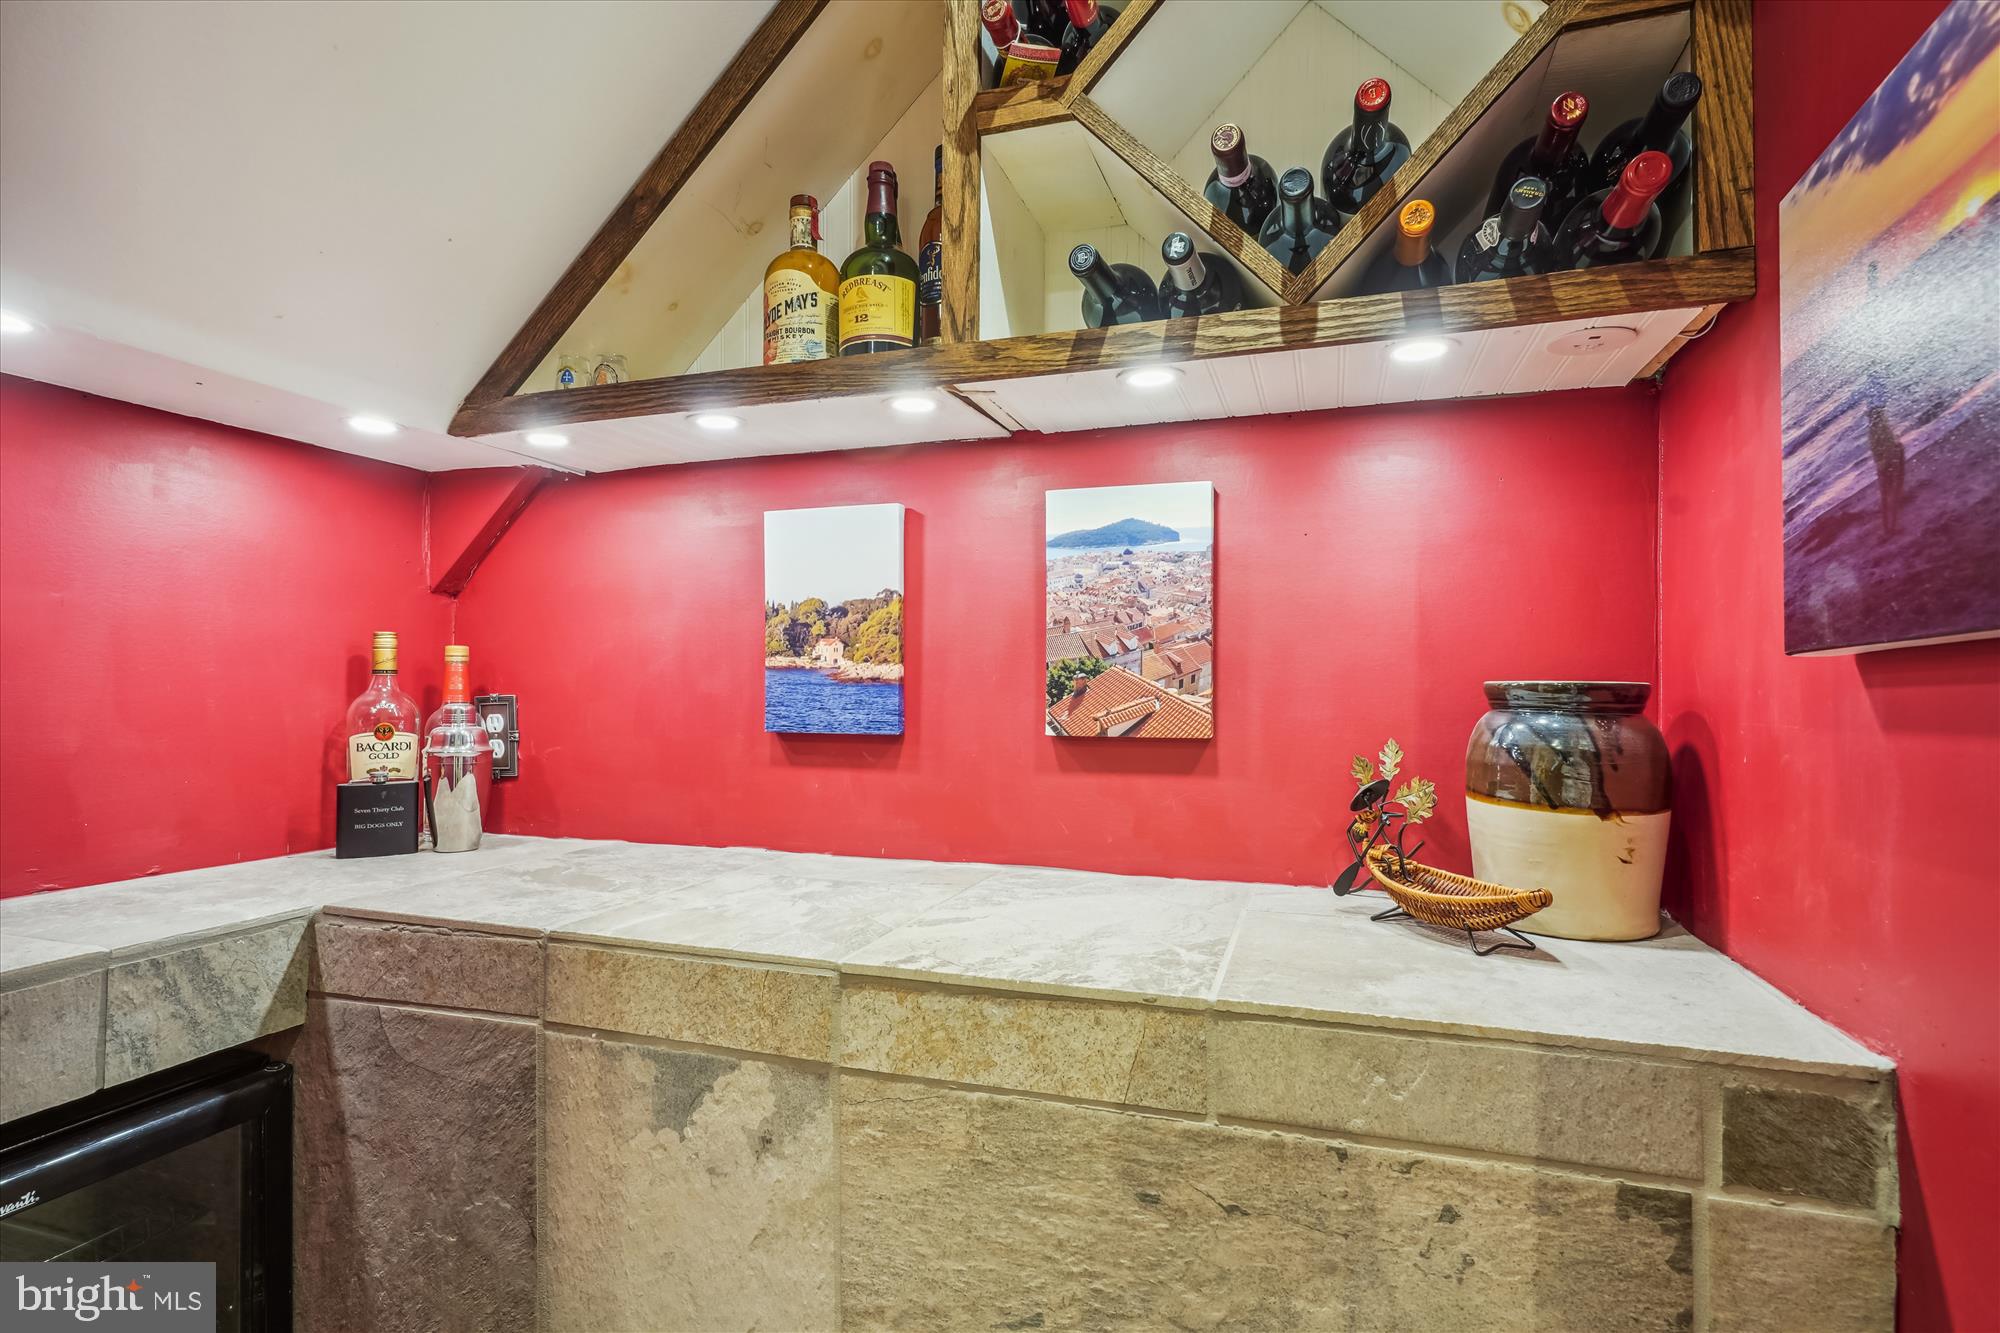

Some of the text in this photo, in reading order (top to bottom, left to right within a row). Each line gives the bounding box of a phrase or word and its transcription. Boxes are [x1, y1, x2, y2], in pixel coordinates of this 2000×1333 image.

[842, 278, 888, 299] REDBREAST
[784, 292, 818, 316] MAY'S
[854, 313, 869, 324] 12
[784, 327, 816, 335] BOURBON
[356, 741, 412, 752] BACARDI
[368, 752, 400, 760] GOLD
[0, 1190, 40, 1216] vanti
